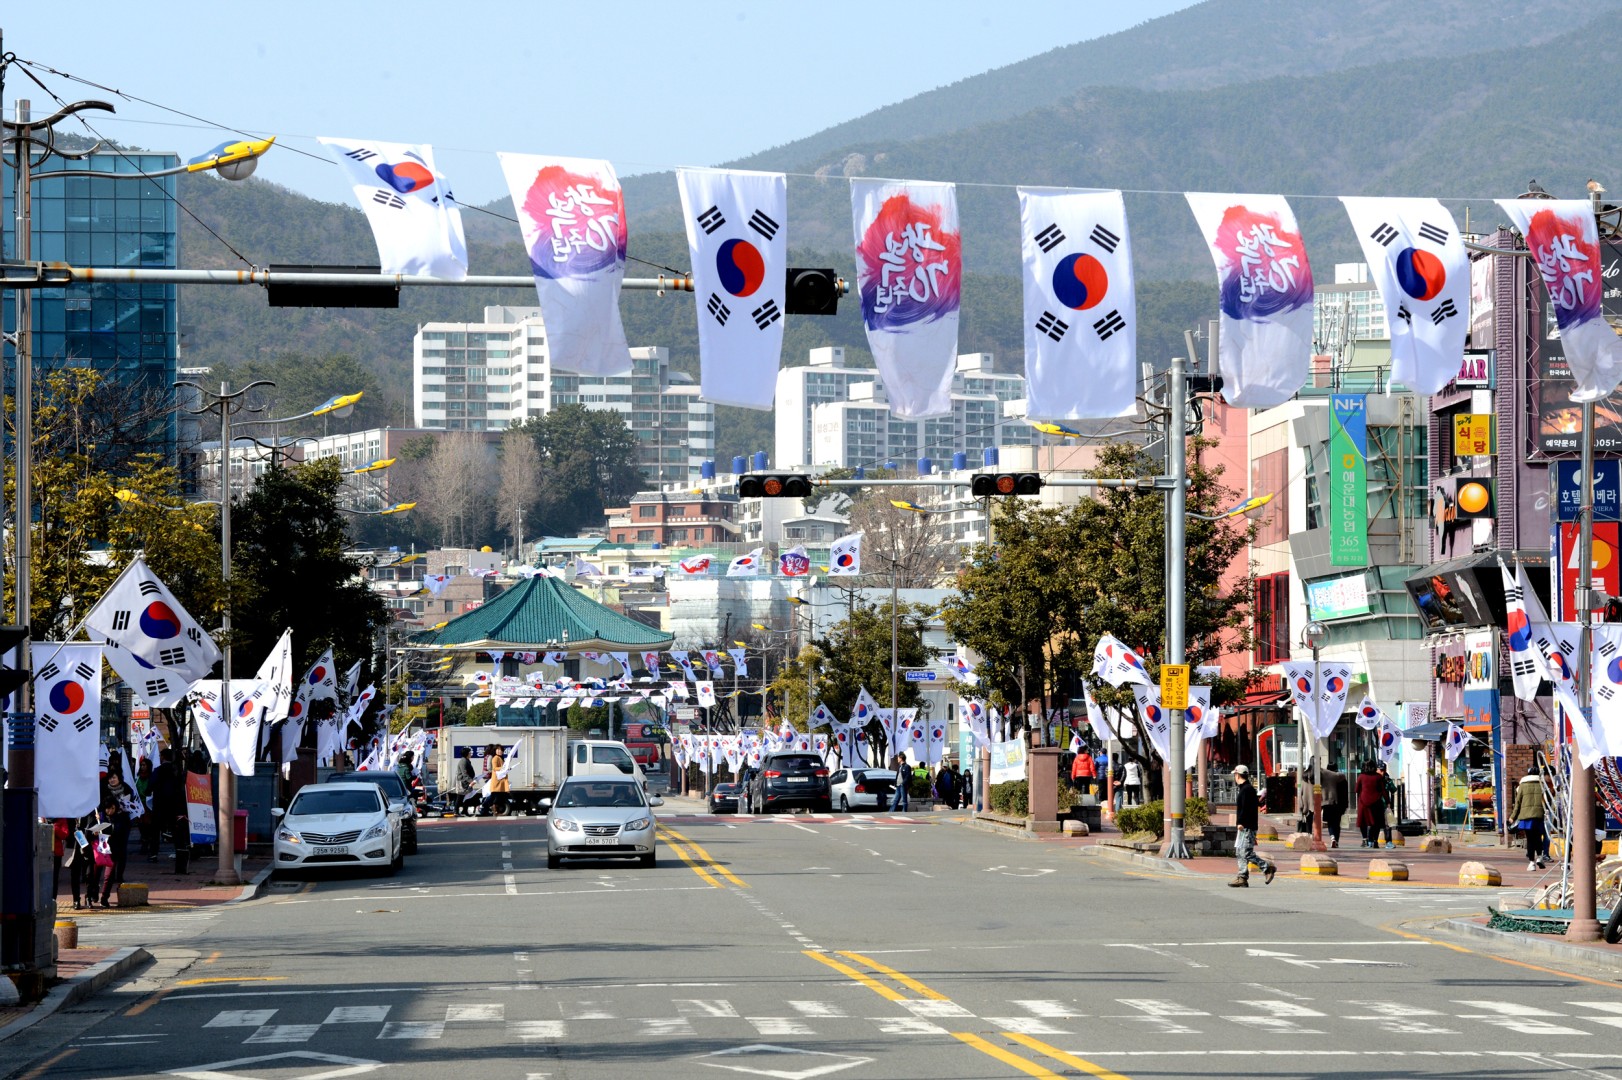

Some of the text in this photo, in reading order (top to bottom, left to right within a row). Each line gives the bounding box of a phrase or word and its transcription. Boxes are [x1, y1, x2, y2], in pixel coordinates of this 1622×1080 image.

[1458, 358, 1487, 380] BAR
[1335, 398, 1364, 410] NH
[1545, 439, 1577, 448] 예약문의
[1561, 489, 1581, 504] 호텔
[1340, 535, 1359, 546] 365
